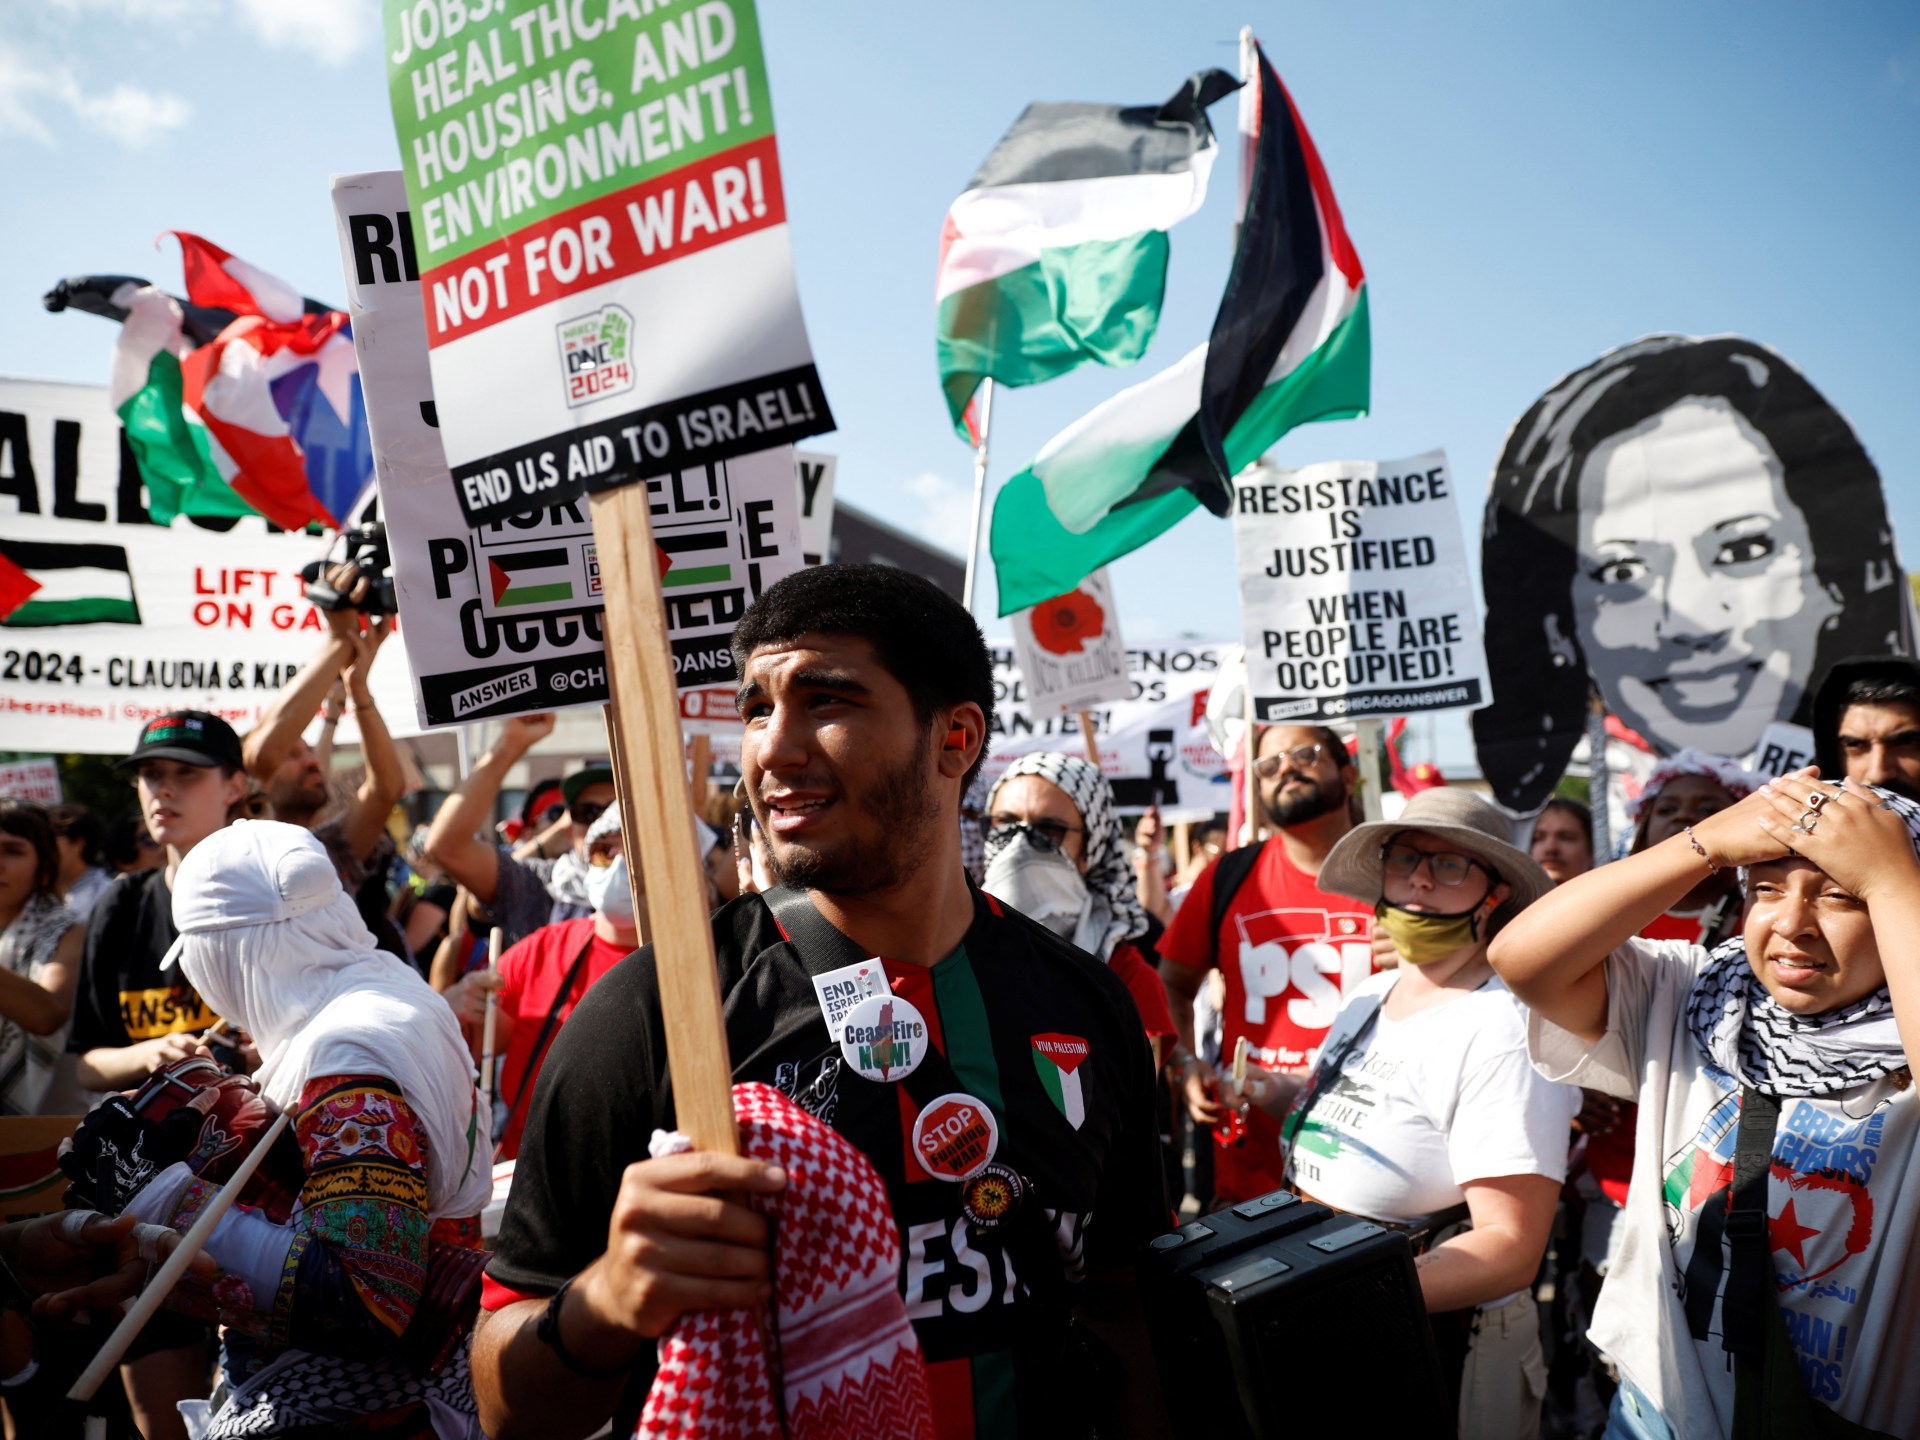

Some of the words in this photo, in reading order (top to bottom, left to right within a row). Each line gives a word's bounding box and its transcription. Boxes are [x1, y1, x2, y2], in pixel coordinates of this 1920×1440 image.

[411, 0, 680, 121] HEALTHCA
[411, 58, 613, 188] HOUSING,
[630, 1, 736, 94] AND
[421, 66, 753, 253] ENVIRONMENT!
[432, 253, 510, 333] NOT
[524, 215, 612, 295] FOR
[627, 157, 768, 257] WAR!
[567, 342, 611, 374] DNC
[570, 362, 629, 399] 2024
[461, 467, 511, 511] END
[517, 452, 557, 493] U.S
[567, 435, 614, 481] AID
[622, 420, 670, 462] TO
[678, 384, 816, 450] ISRAEL!
[1238, 467, 1448, 514] RESISTANCE
[1329, 511, 1362, 539] IS
[1265, 536, 1436, 578] JUSTIFIED
[194, 567, 277, 596] LIFT
[193, 601, 252, 628] ON
[1308, 590, 1407, 625] WHEN
[1263, 622, 1386, 658] PEOPLE
[1399, 614, 1462, 649] ARE
[4, 651, 84, 682] 2024
[108, 658, 220, 689] CLAUDIA
[229, 662, 245, 689] &
[254, 663, 305, 690] KAR
[1277, 647, 1455, 690] OCCUPIED!
[459, 673, 531, 712] ANSWER
[822, 980, 856, 1002] END
[858, 1041, 911, 1071] NOW!
[1035, 1041, 1053, 1053] VIVA
[1053, 1042, 1087, 1054] PALESTINA
[921, 1107, 973, 1152] STOP
[930, 1122, 986, 1167] Funding
[948, 1142, 984, 1172] WAR!
[1809, 1280, 1857, 1304] الخبز
